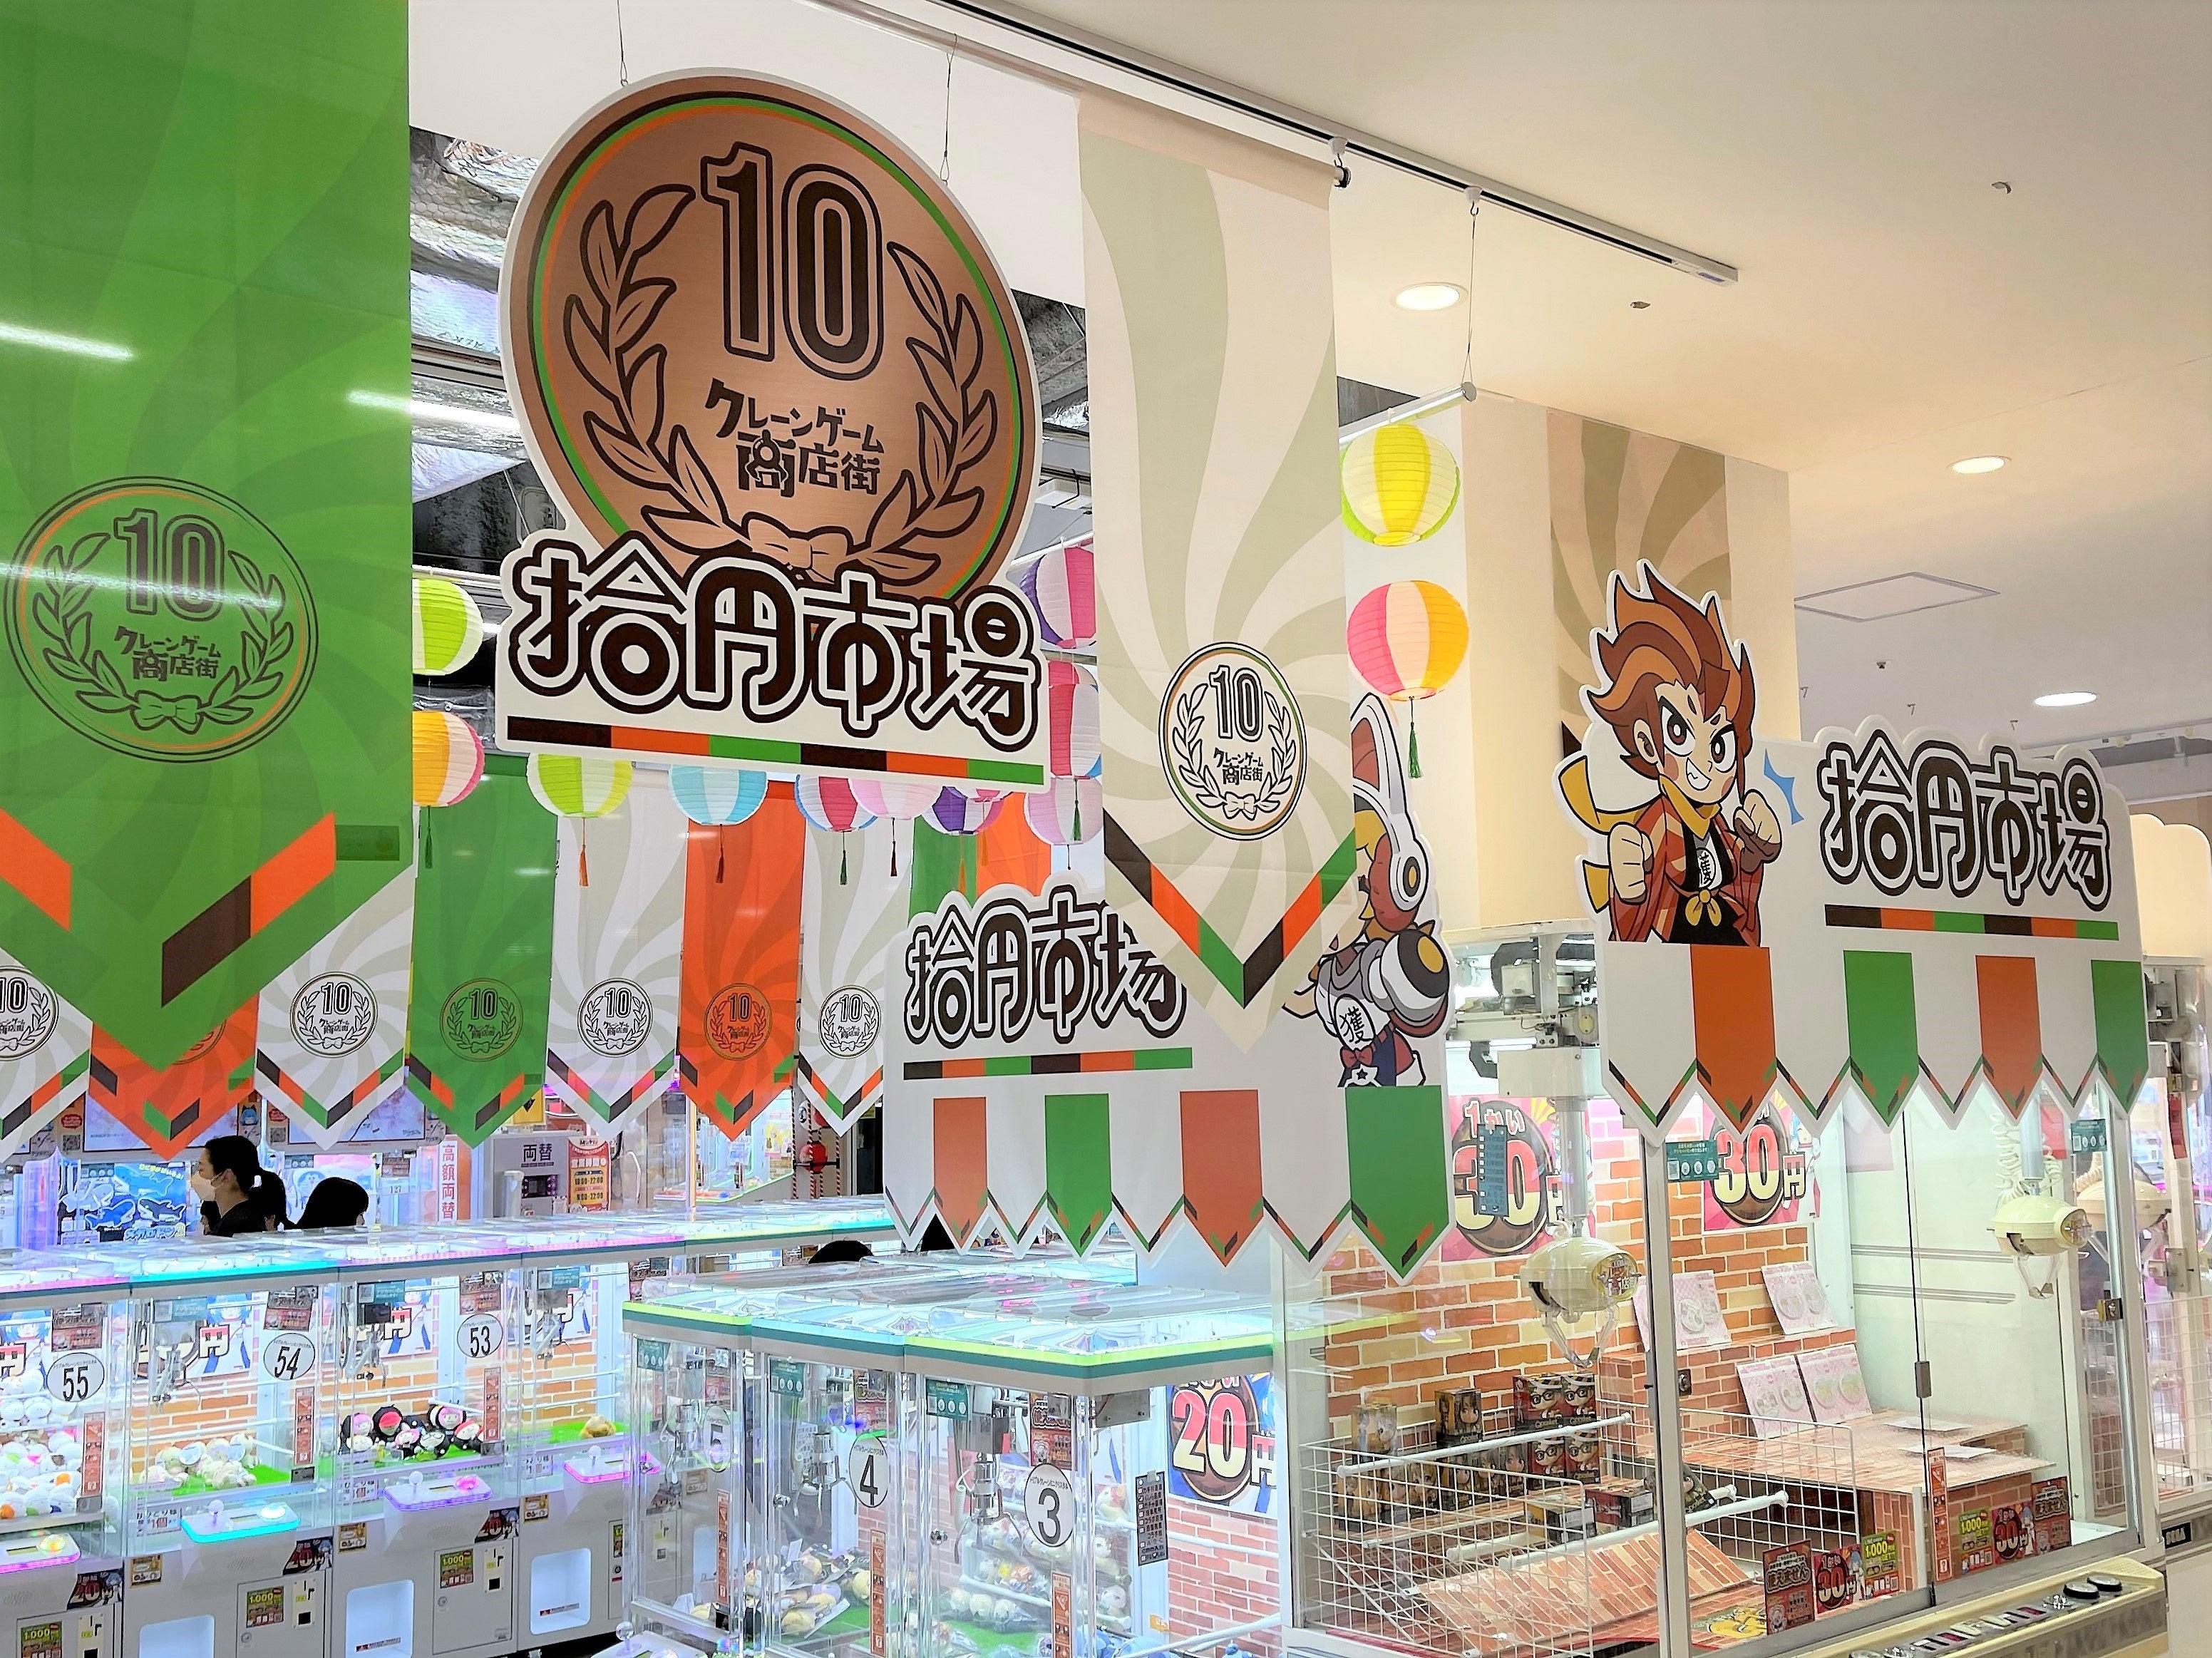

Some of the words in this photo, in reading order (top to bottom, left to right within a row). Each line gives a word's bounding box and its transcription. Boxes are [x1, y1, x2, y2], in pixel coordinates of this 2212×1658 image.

[701, 143, 883, 380] 10
[705, 377, 883, 454] クレーンゲーム
[739, 429, 878, 498] 商店街
[114, 508, 225, 621] 10
[115, 626, 220, 657] クレーンゲーム
[507, 530, 1041, 752] 拾円市場
[133, 649, 219, 681] 商店街
[1209, 665, 1263, 742] 10
[1213, 748, 1263, 767] クレーンゲーム
[1223, 763, 1262, 786] 商店街
[1817, 729, 2112, 912] 拾円市場
[321, 982, 352, 1014] 10
[468, 989, 498, 1020] 10
[605, 987, 632, 1018] 10
[728, 993, 751, 1021] 10
[840, 994, 863, 1022] 10
[1339, 1006, 1374, 1044] 獲
[523, 1143, 552, 1162] 両替
[390, 1185, 402, 1194] 127
[442, 1145, 455, 1220] 高額両替
[470, 1326, 490, 1357] 53
[274, 1347, 302, 1380] 54
[63, 1365, 88, 1402] 55
[860, 1455, 878, 1505] 4
[1039, 1488, 1061, 1545] 3
